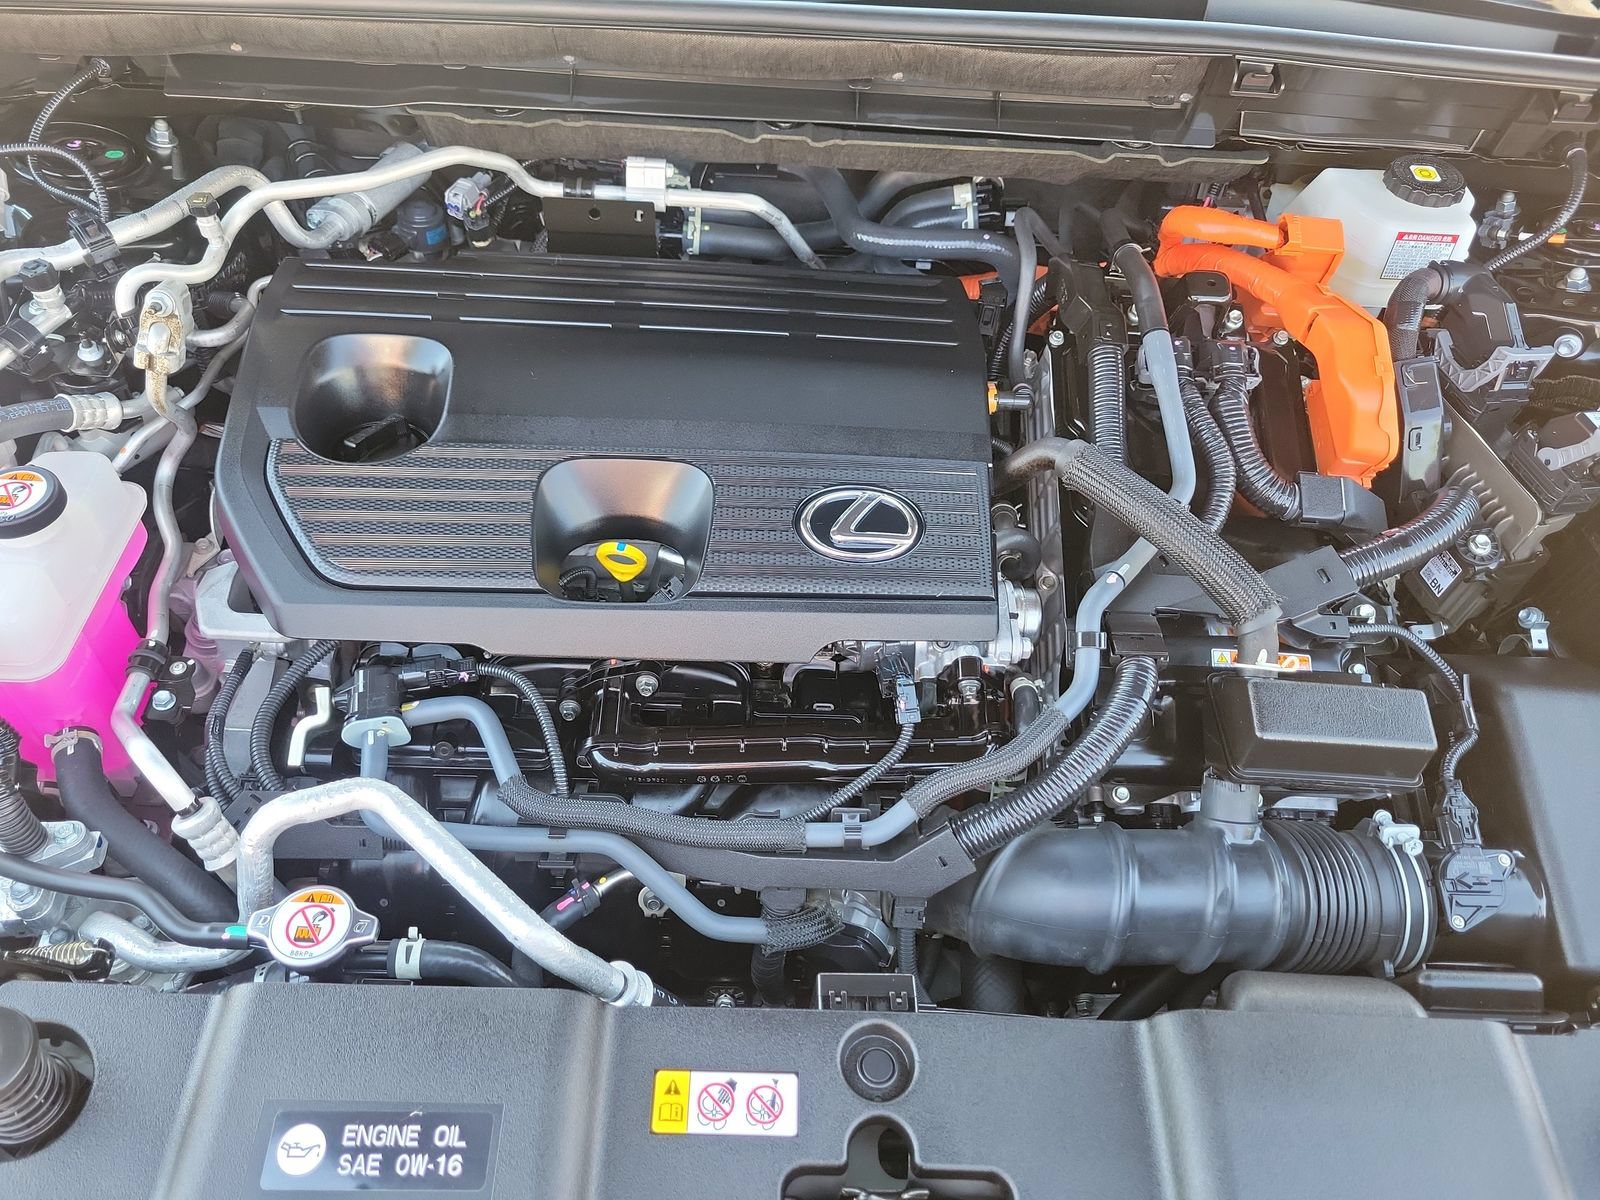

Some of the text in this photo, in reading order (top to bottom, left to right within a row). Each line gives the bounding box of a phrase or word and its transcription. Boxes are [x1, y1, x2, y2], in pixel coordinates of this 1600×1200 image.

[1418, 234, 1442, 242] DANGER
[1430, 577, 1444, 594] BN
[342, 1124, 467, 1147] ENGINE OIL
[337, 1154, 464, 1177] SAE 0W-16
